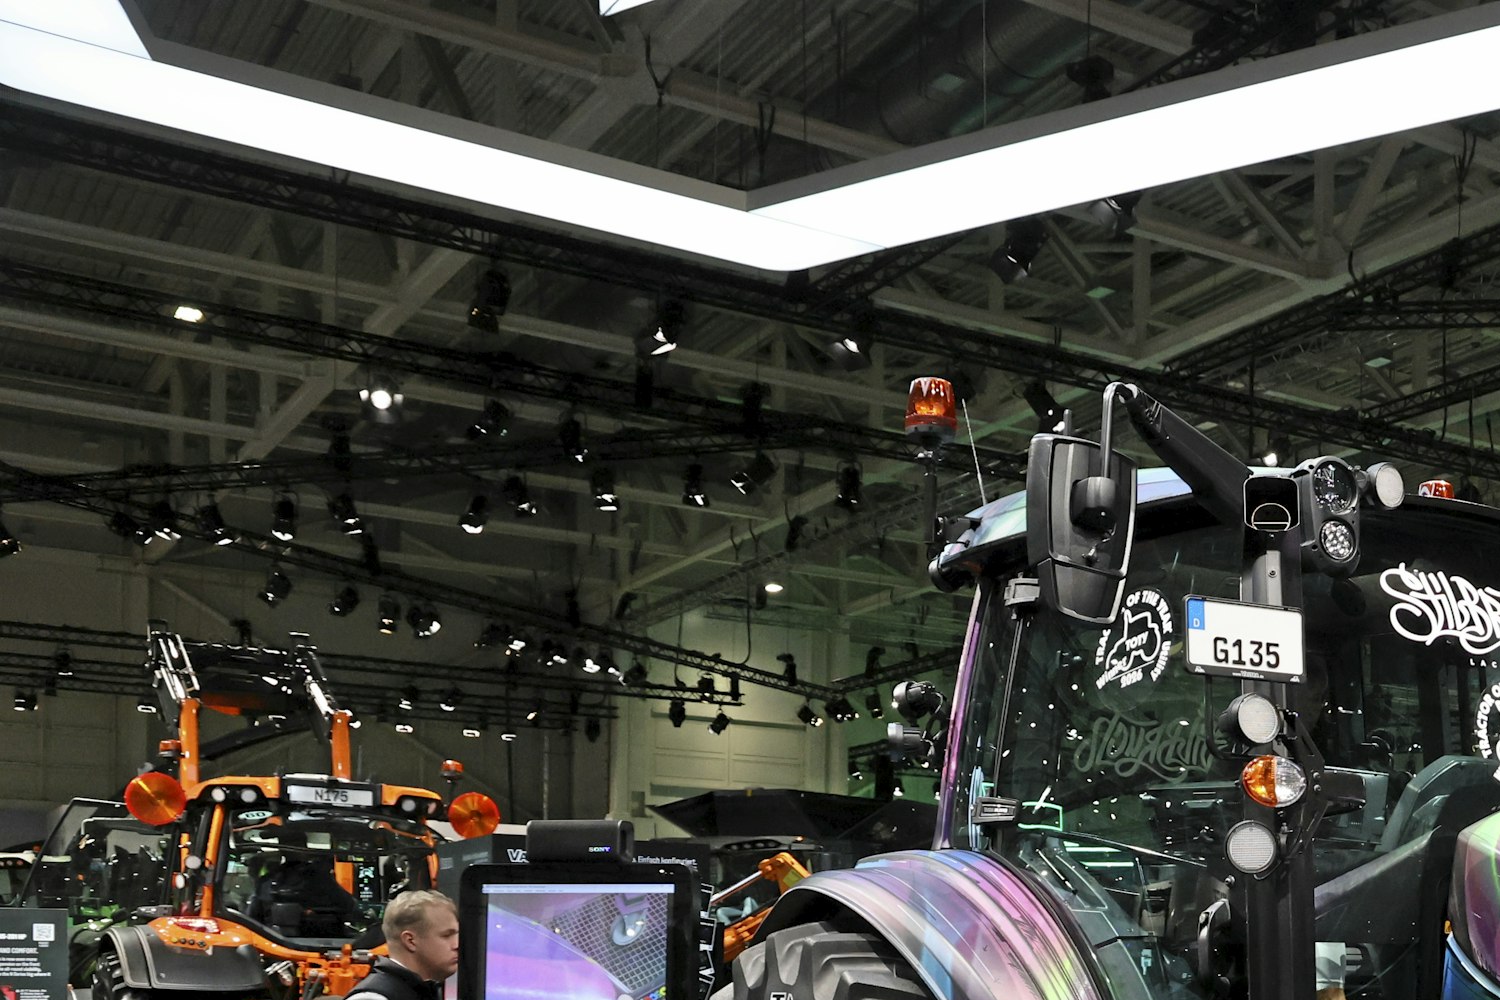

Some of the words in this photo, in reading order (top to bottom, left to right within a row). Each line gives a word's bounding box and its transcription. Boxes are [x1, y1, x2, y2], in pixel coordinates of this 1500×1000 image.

[1126, 591, 1141, 607] OF
[1142, 590, 1160, 607] THE
[1156, 598, 1173, 634] YEAR
[1193, 618, 1200, 627] D
[1125, 631, 1149, 651] TOTY
[1213, 637, 1281, 669] G135
[1120, 668, 1143, 688] 2026
[1476, 693, 1496, 759] TRACTOR
[314, 790, 349, 803] N175
